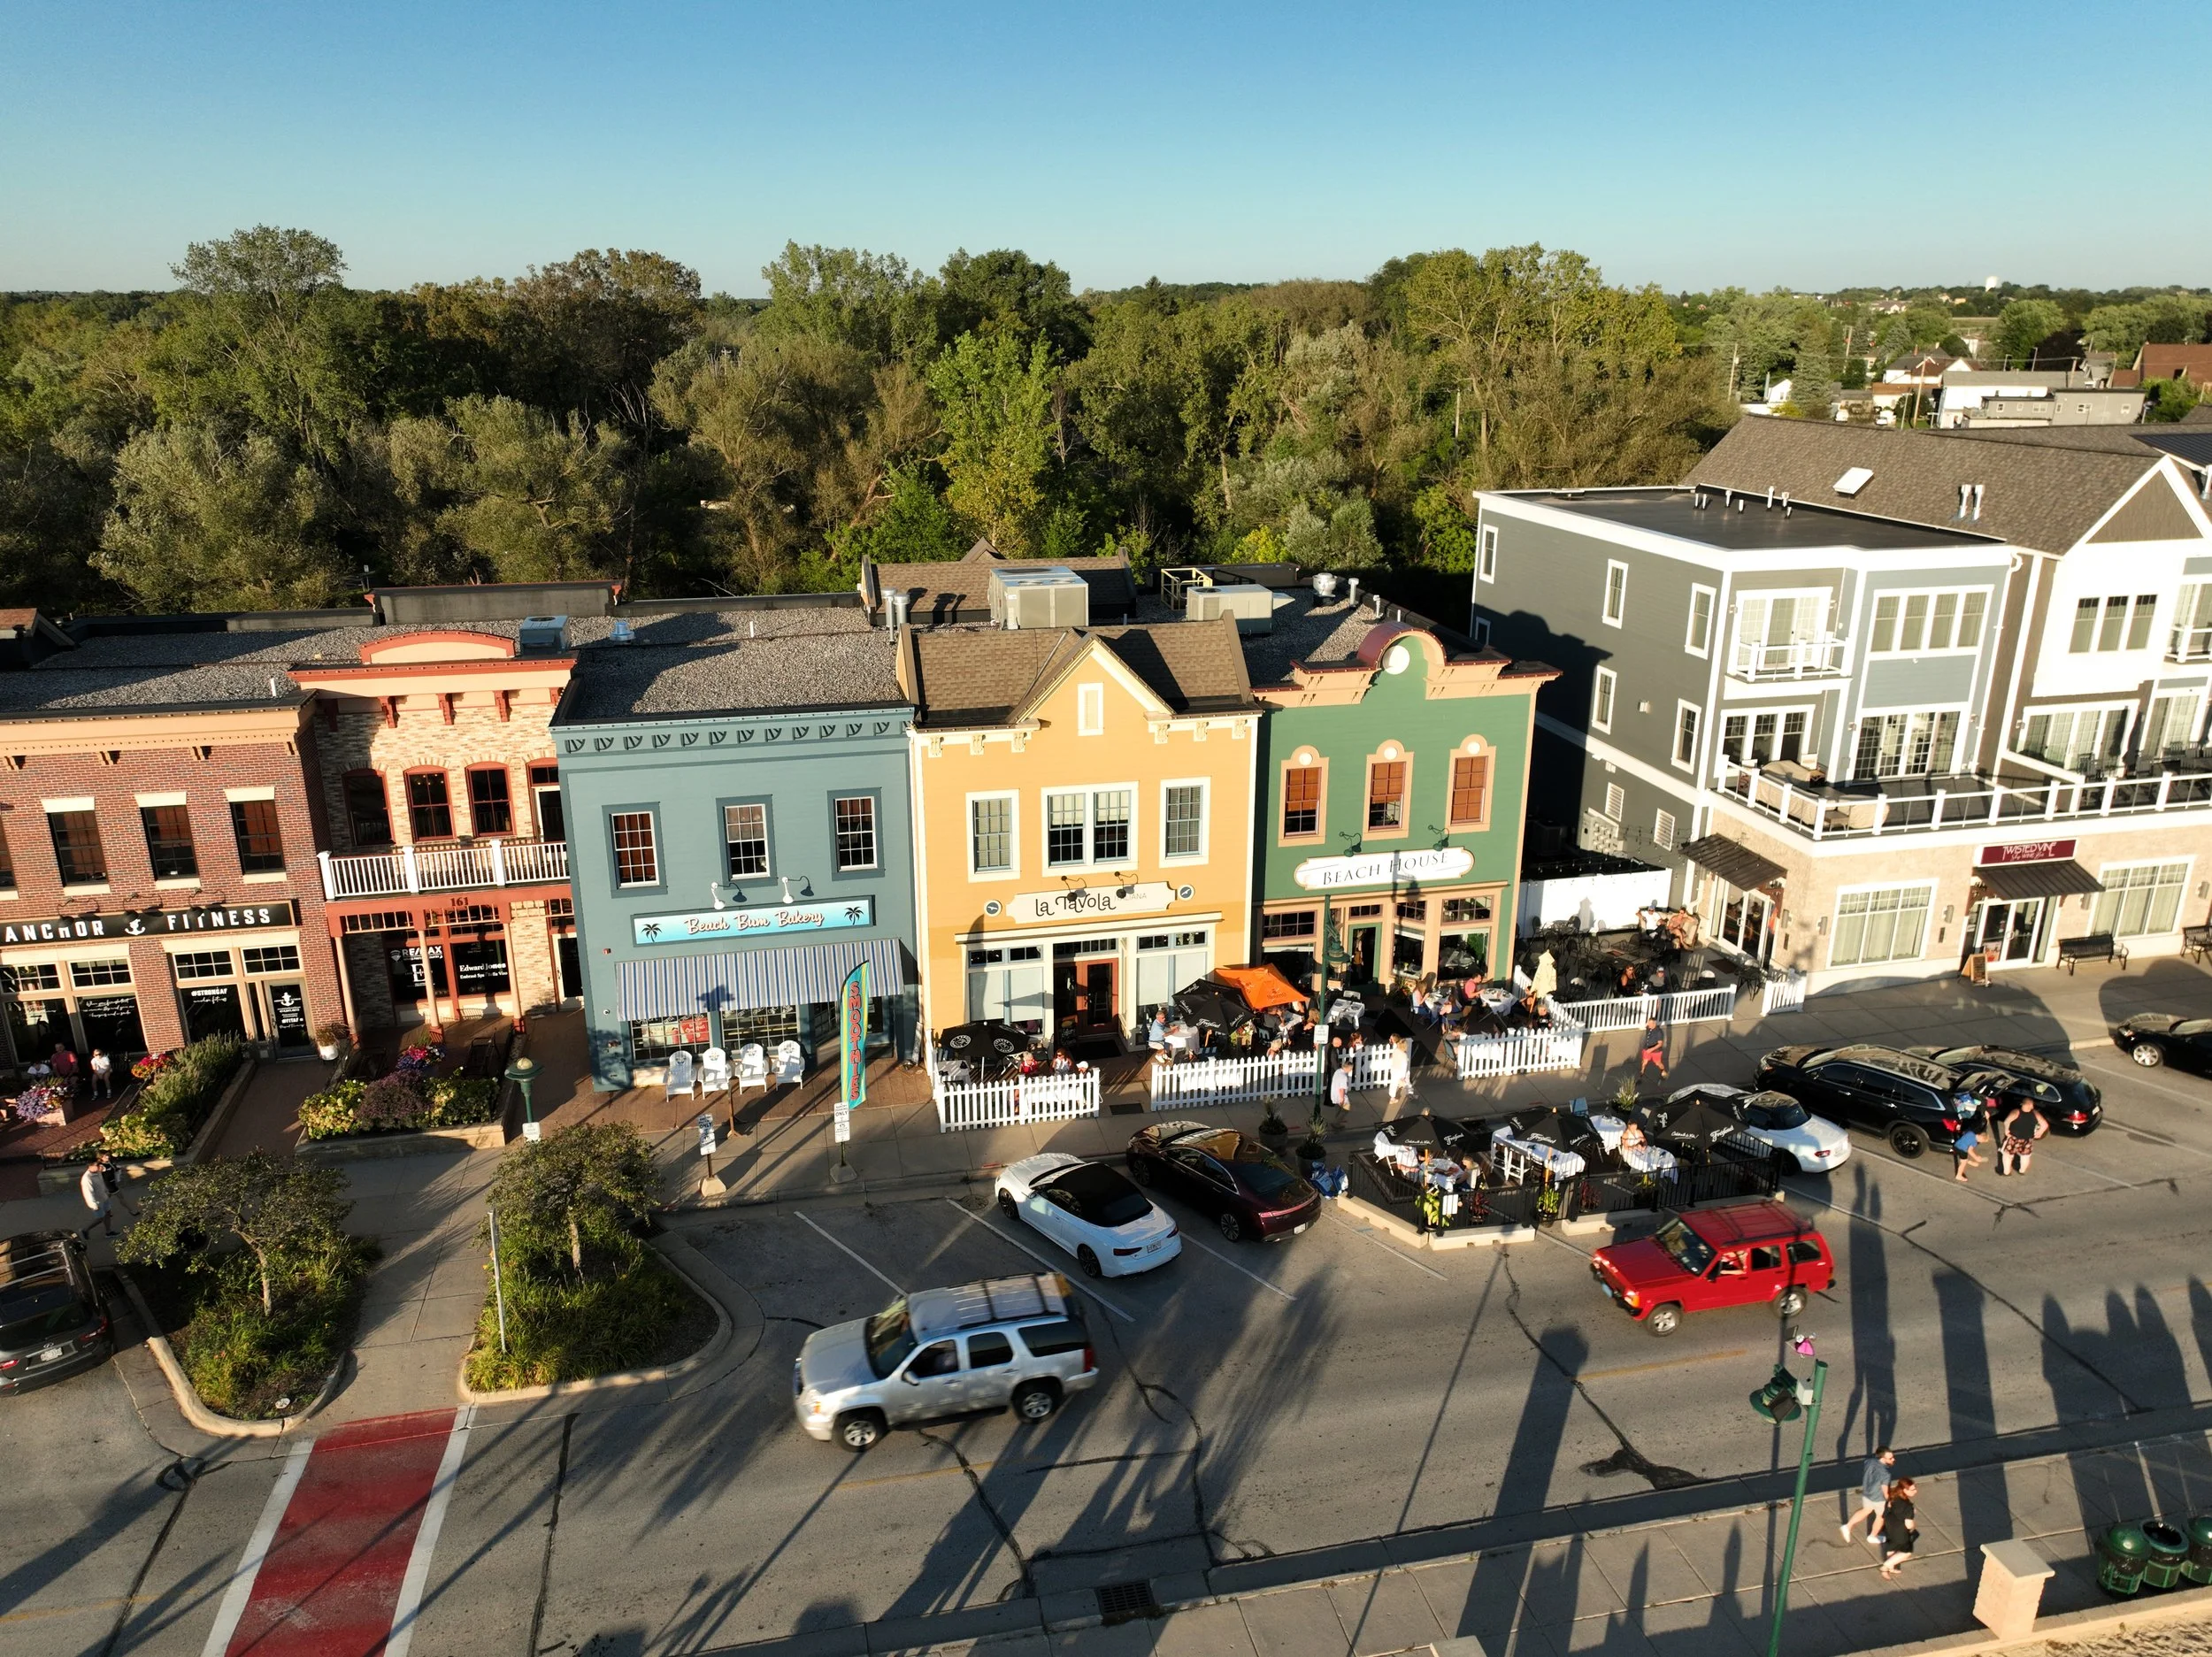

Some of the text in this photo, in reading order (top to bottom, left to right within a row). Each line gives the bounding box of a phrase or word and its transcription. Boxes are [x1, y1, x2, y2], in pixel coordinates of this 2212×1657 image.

[1323, 852, 1449, 886] BEACH HOUSE
[450, 897, 469, 907] 161
[1055, 893, 1117, 914] Tavola
[5, 908, 271, 943] ANCHOR FITNESS
[684, 909, 825, 935] Beach Bum Bakery
[402, 946, 442, 955] RE/AX
[459, 963, 506, 972] Edward Jones
[849, 980, 862, 1101] SMOOTHIES
